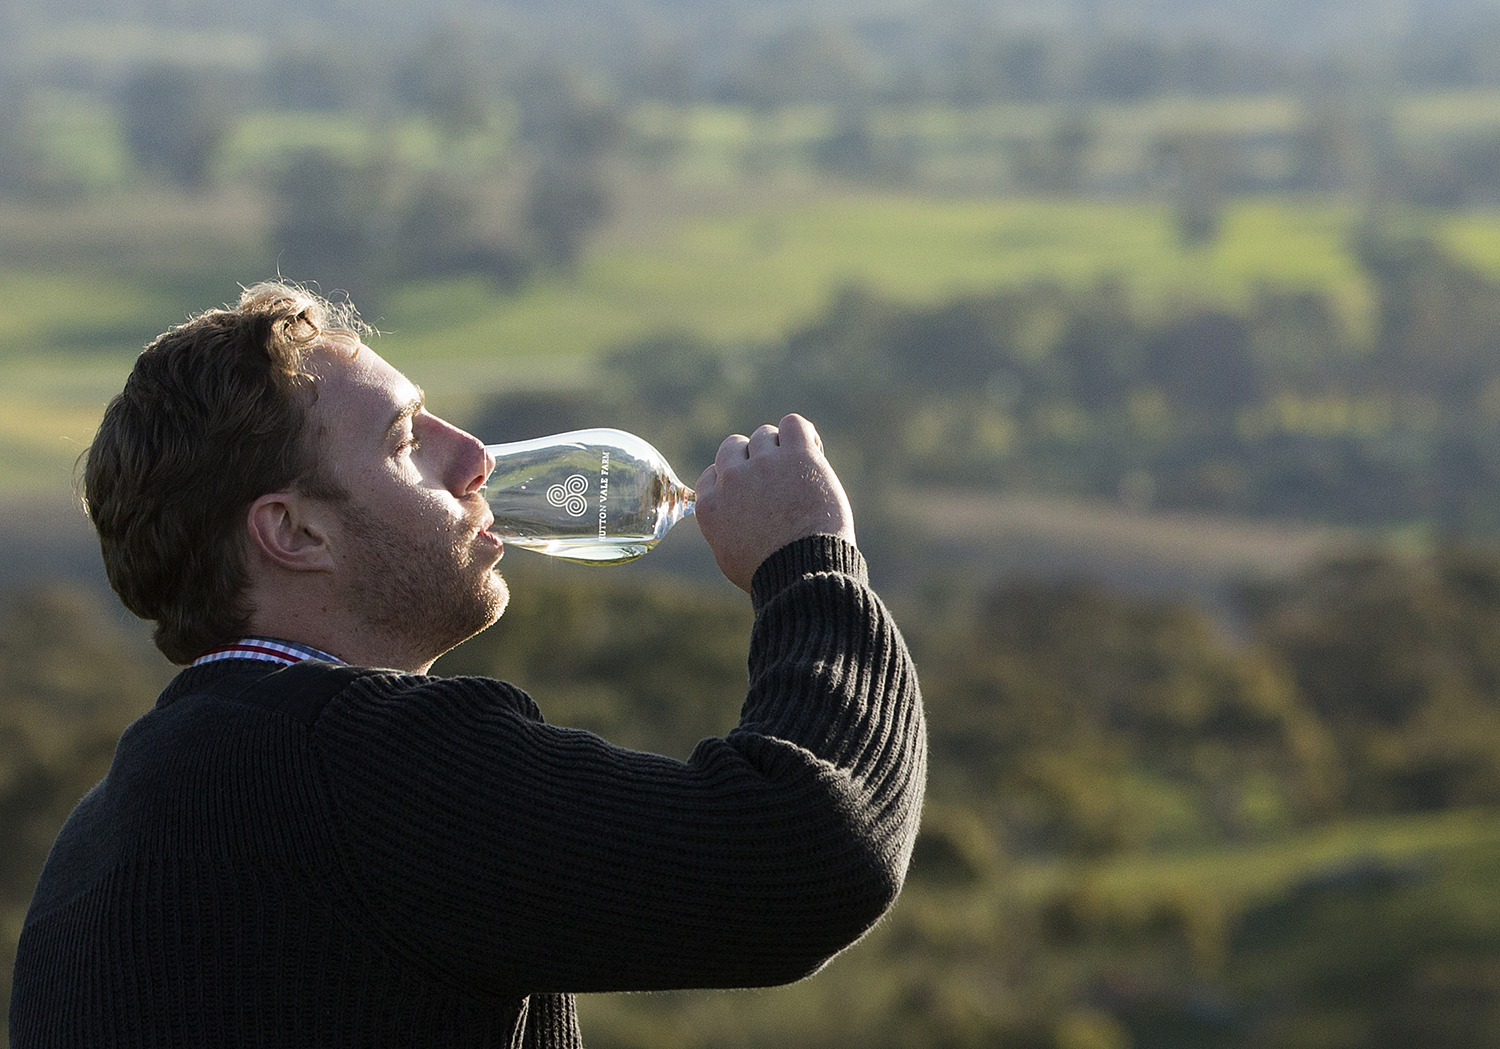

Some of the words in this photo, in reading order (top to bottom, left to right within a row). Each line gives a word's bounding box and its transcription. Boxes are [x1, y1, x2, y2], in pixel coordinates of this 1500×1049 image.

[601, 450, 610, 475] FARM
[600, 477, 609, 502] VALE
[598, 505, 607, 542] HUTTON
